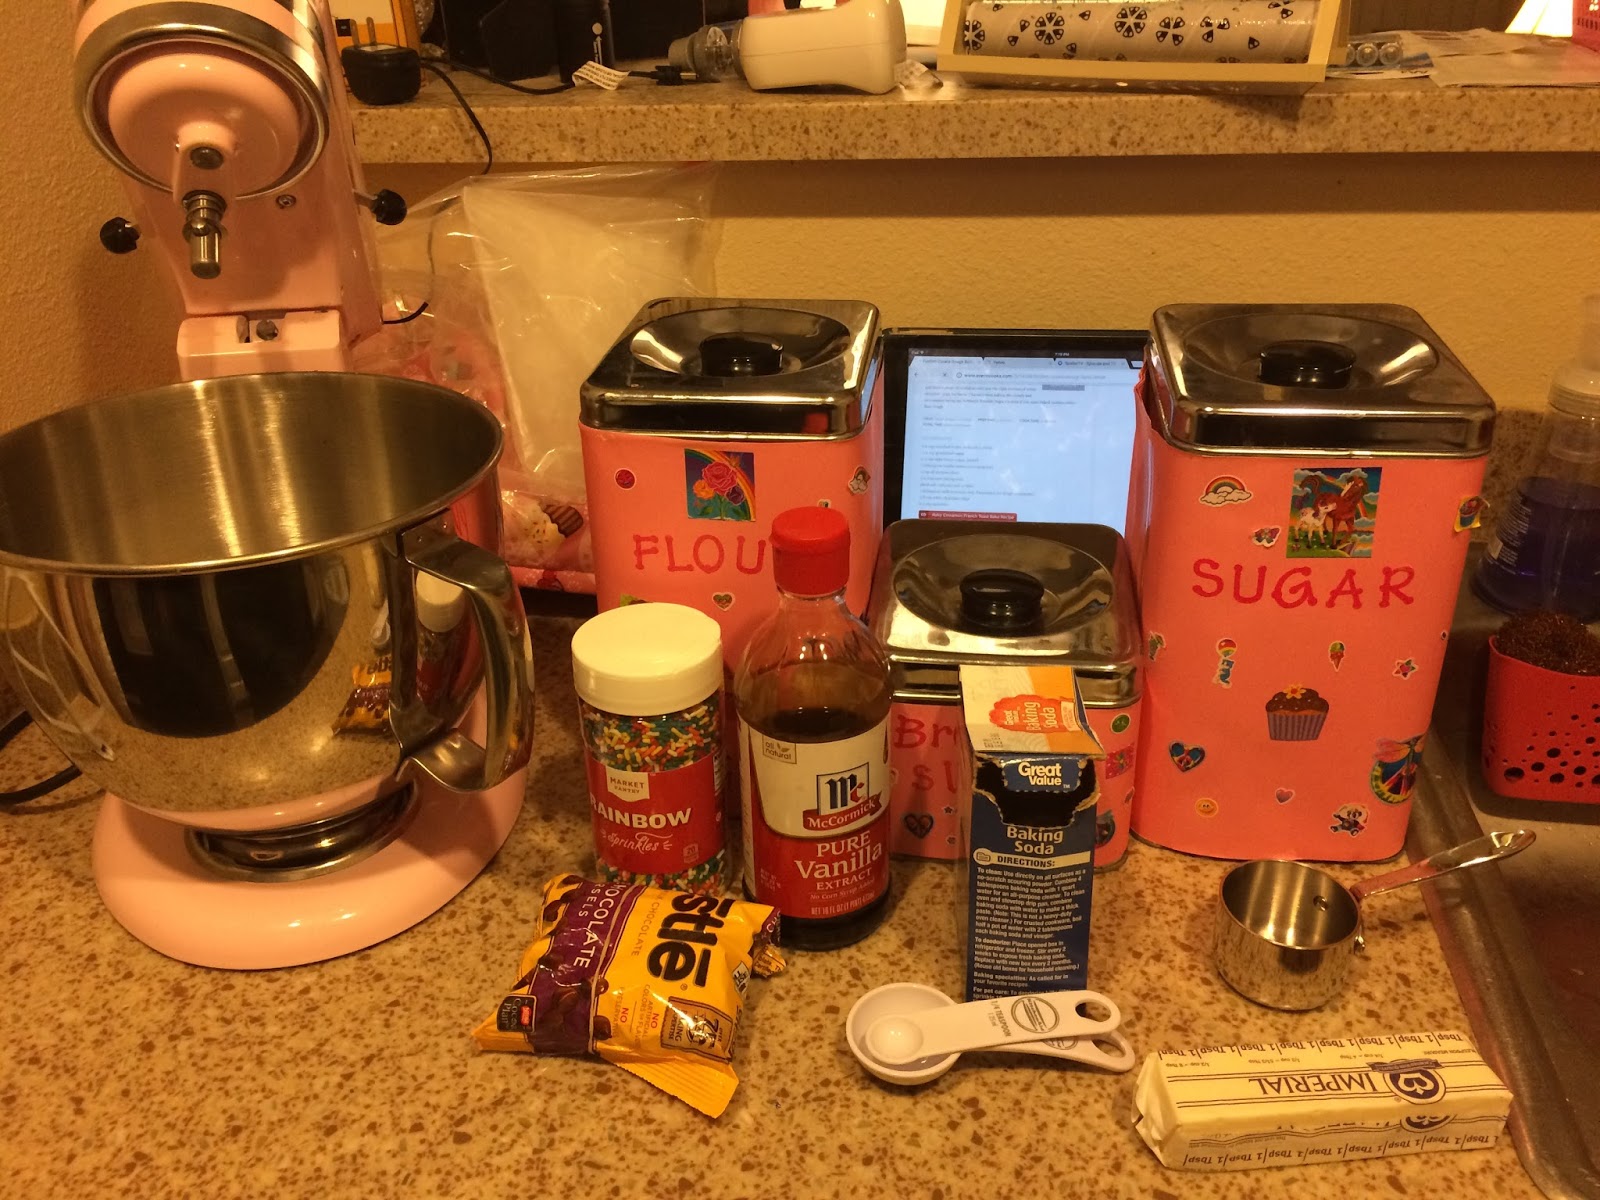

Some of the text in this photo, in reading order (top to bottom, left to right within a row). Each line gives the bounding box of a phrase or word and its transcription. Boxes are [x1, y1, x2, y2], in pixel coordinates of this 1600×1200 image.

[632, 533, 766, 575] FLOU
[1191, 558, 1415, 610] SUGAR
[1023, 701, 1041, 731] Baking
[765, 741, 774, 749] all
[765, 748, 792, 760] natural
[1018, 762, 1062, 777] Great
[1028, 776, 1062, 786] Value
[610, 777, 645, 789] MARKET
[590, 792, 692, 829] RAINBOW
[807, 800, 876, 829] McCormick
[817, 830, 871, 858] PURE
[1006, 826, 1064, 844] Baking
[1014, 841, 1055, 855] Soda
[794, 841, 883, 879] Vanilla
[997, 855, 1056, 868] DIRECTIONS:
[816, 867, 872, 891] EXTRACT
[578, 884, 605, 917] SELS
[821, 892, 838, 900] Corn
[573, 884, 627, 968] HOCOLATE
[631, 902, 660, 956] CHOCOLATE
[640, 984, 651, 1012] COLORS
[620, 1007, 629, 1023] NO
[650, 1013, 660, 1029] NO
[1248, 1073, 1378, 1095] IMPERIAL
